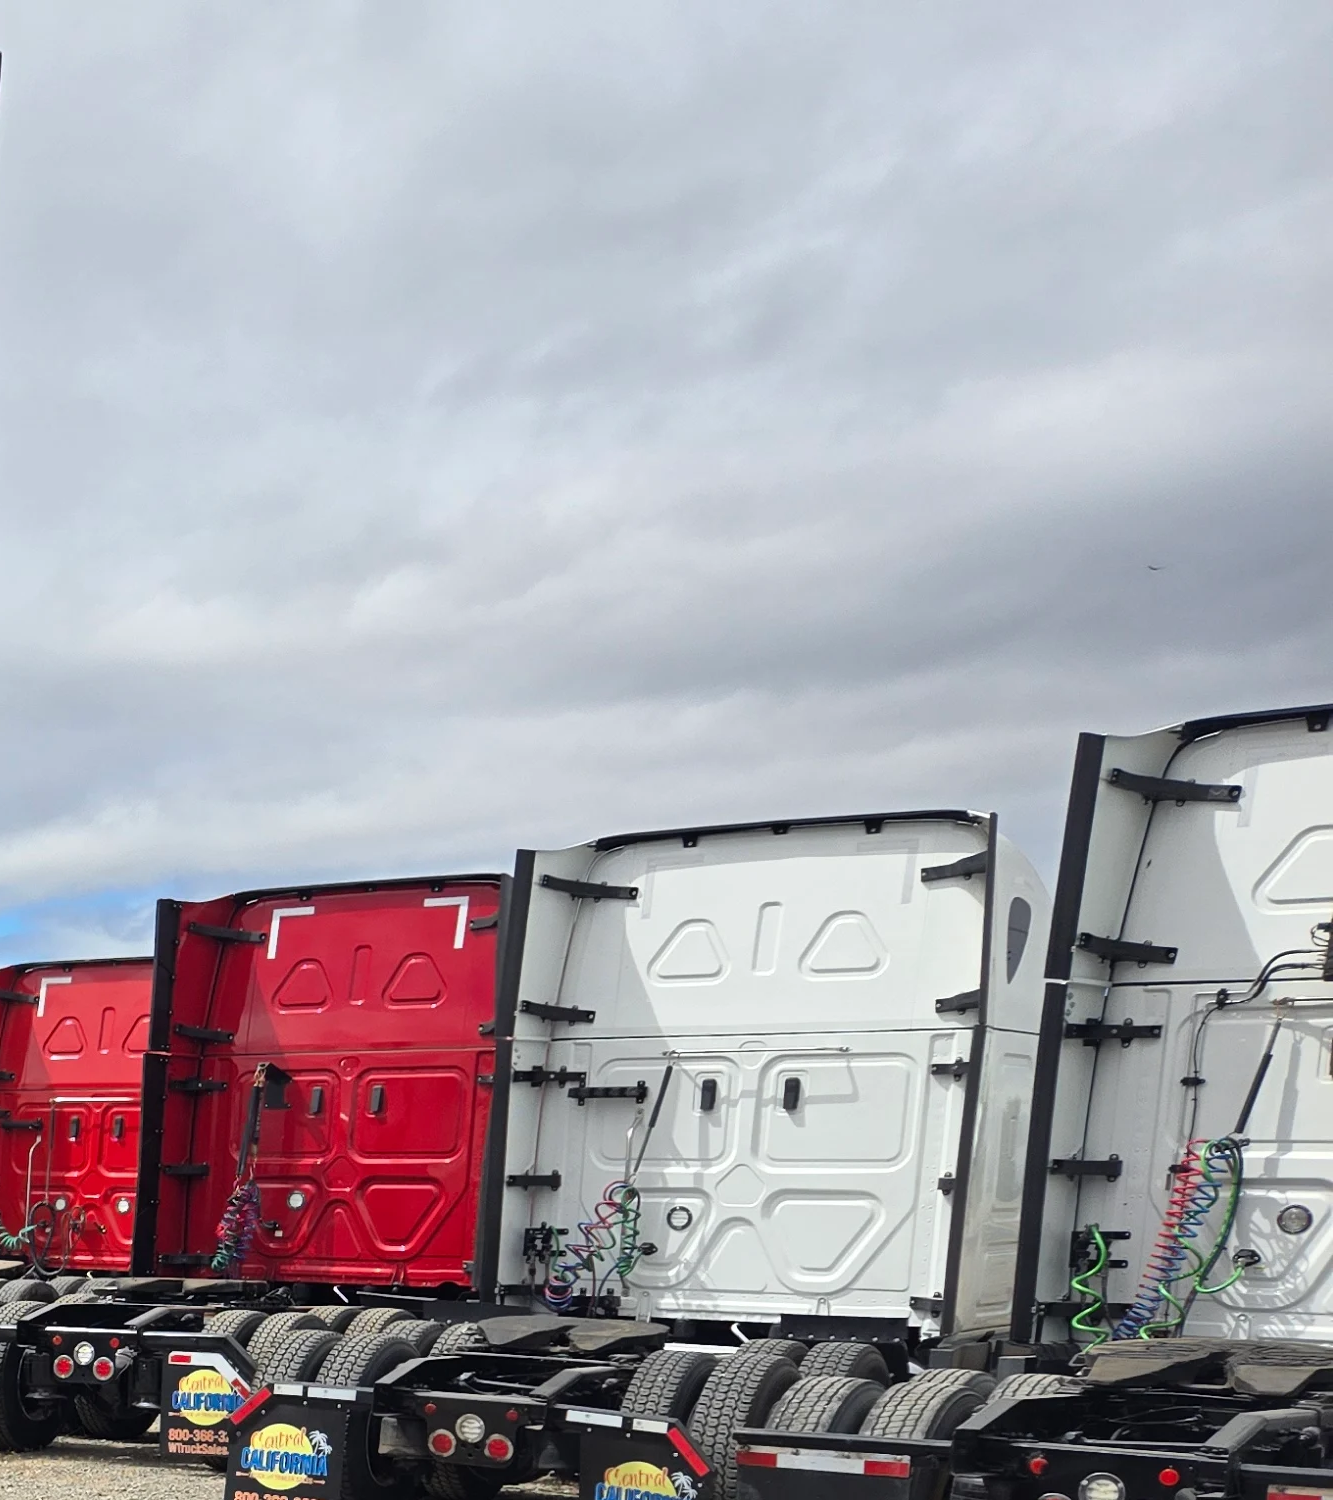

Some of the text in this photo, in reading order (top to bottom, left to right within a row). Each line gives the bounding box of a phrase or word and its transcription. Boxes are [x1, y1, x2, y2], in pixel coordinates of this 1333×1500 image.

[250, 1426, 307, 1450] Central
[240, 1446, 328, 1476] CALIFORNIA
[604, 1466, 669, 1488] Central
